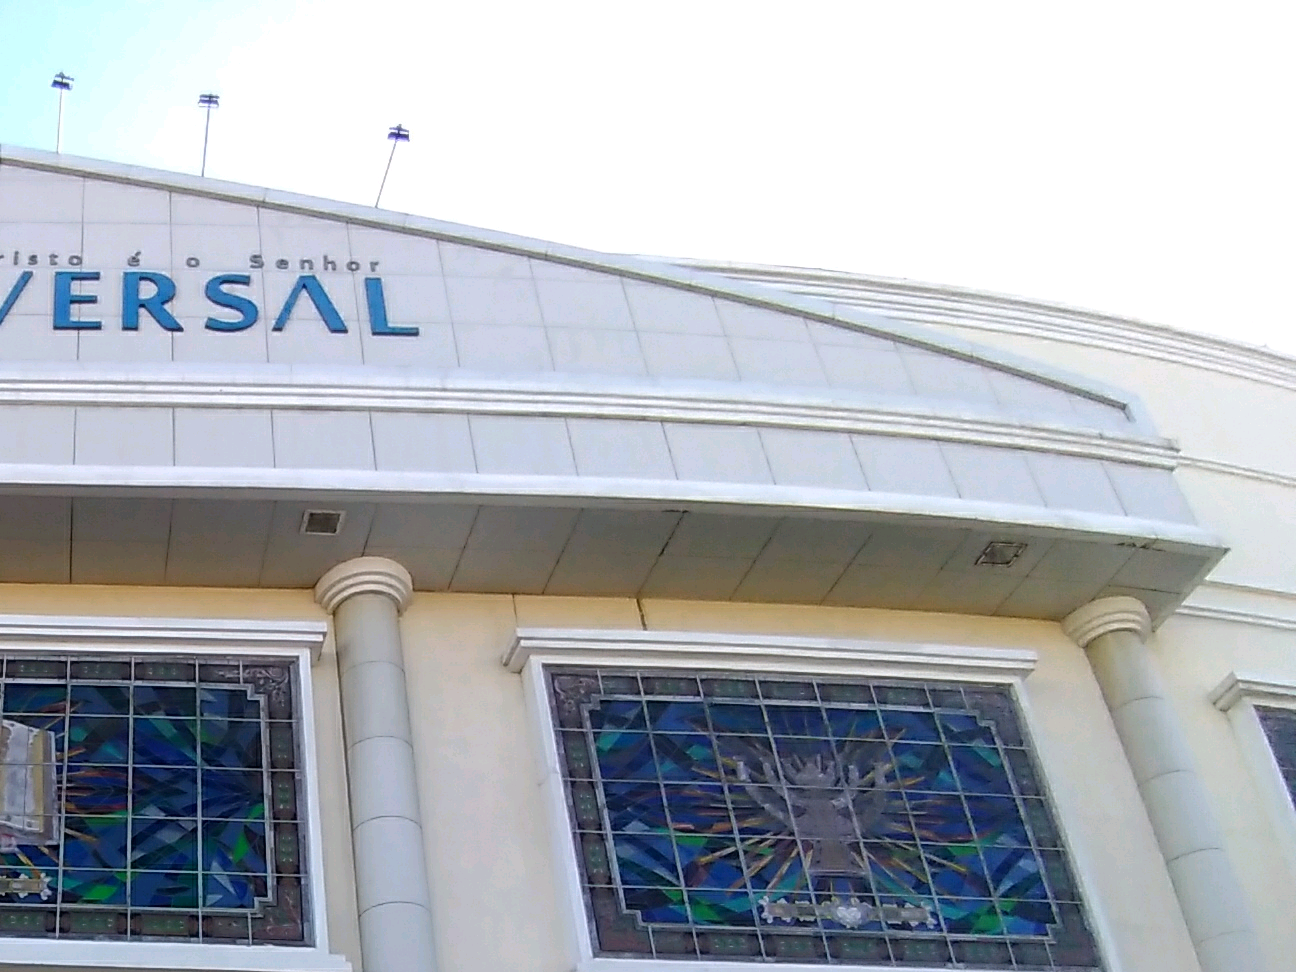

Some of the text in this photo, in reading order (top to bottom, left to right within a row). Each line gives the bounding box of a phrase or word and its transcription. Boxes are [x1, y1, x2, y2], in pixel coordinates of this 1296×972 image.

[126, 251, 142, 267] é
[185, 256, 200, 269] o
[248, 254, 381, 272] Senhor
